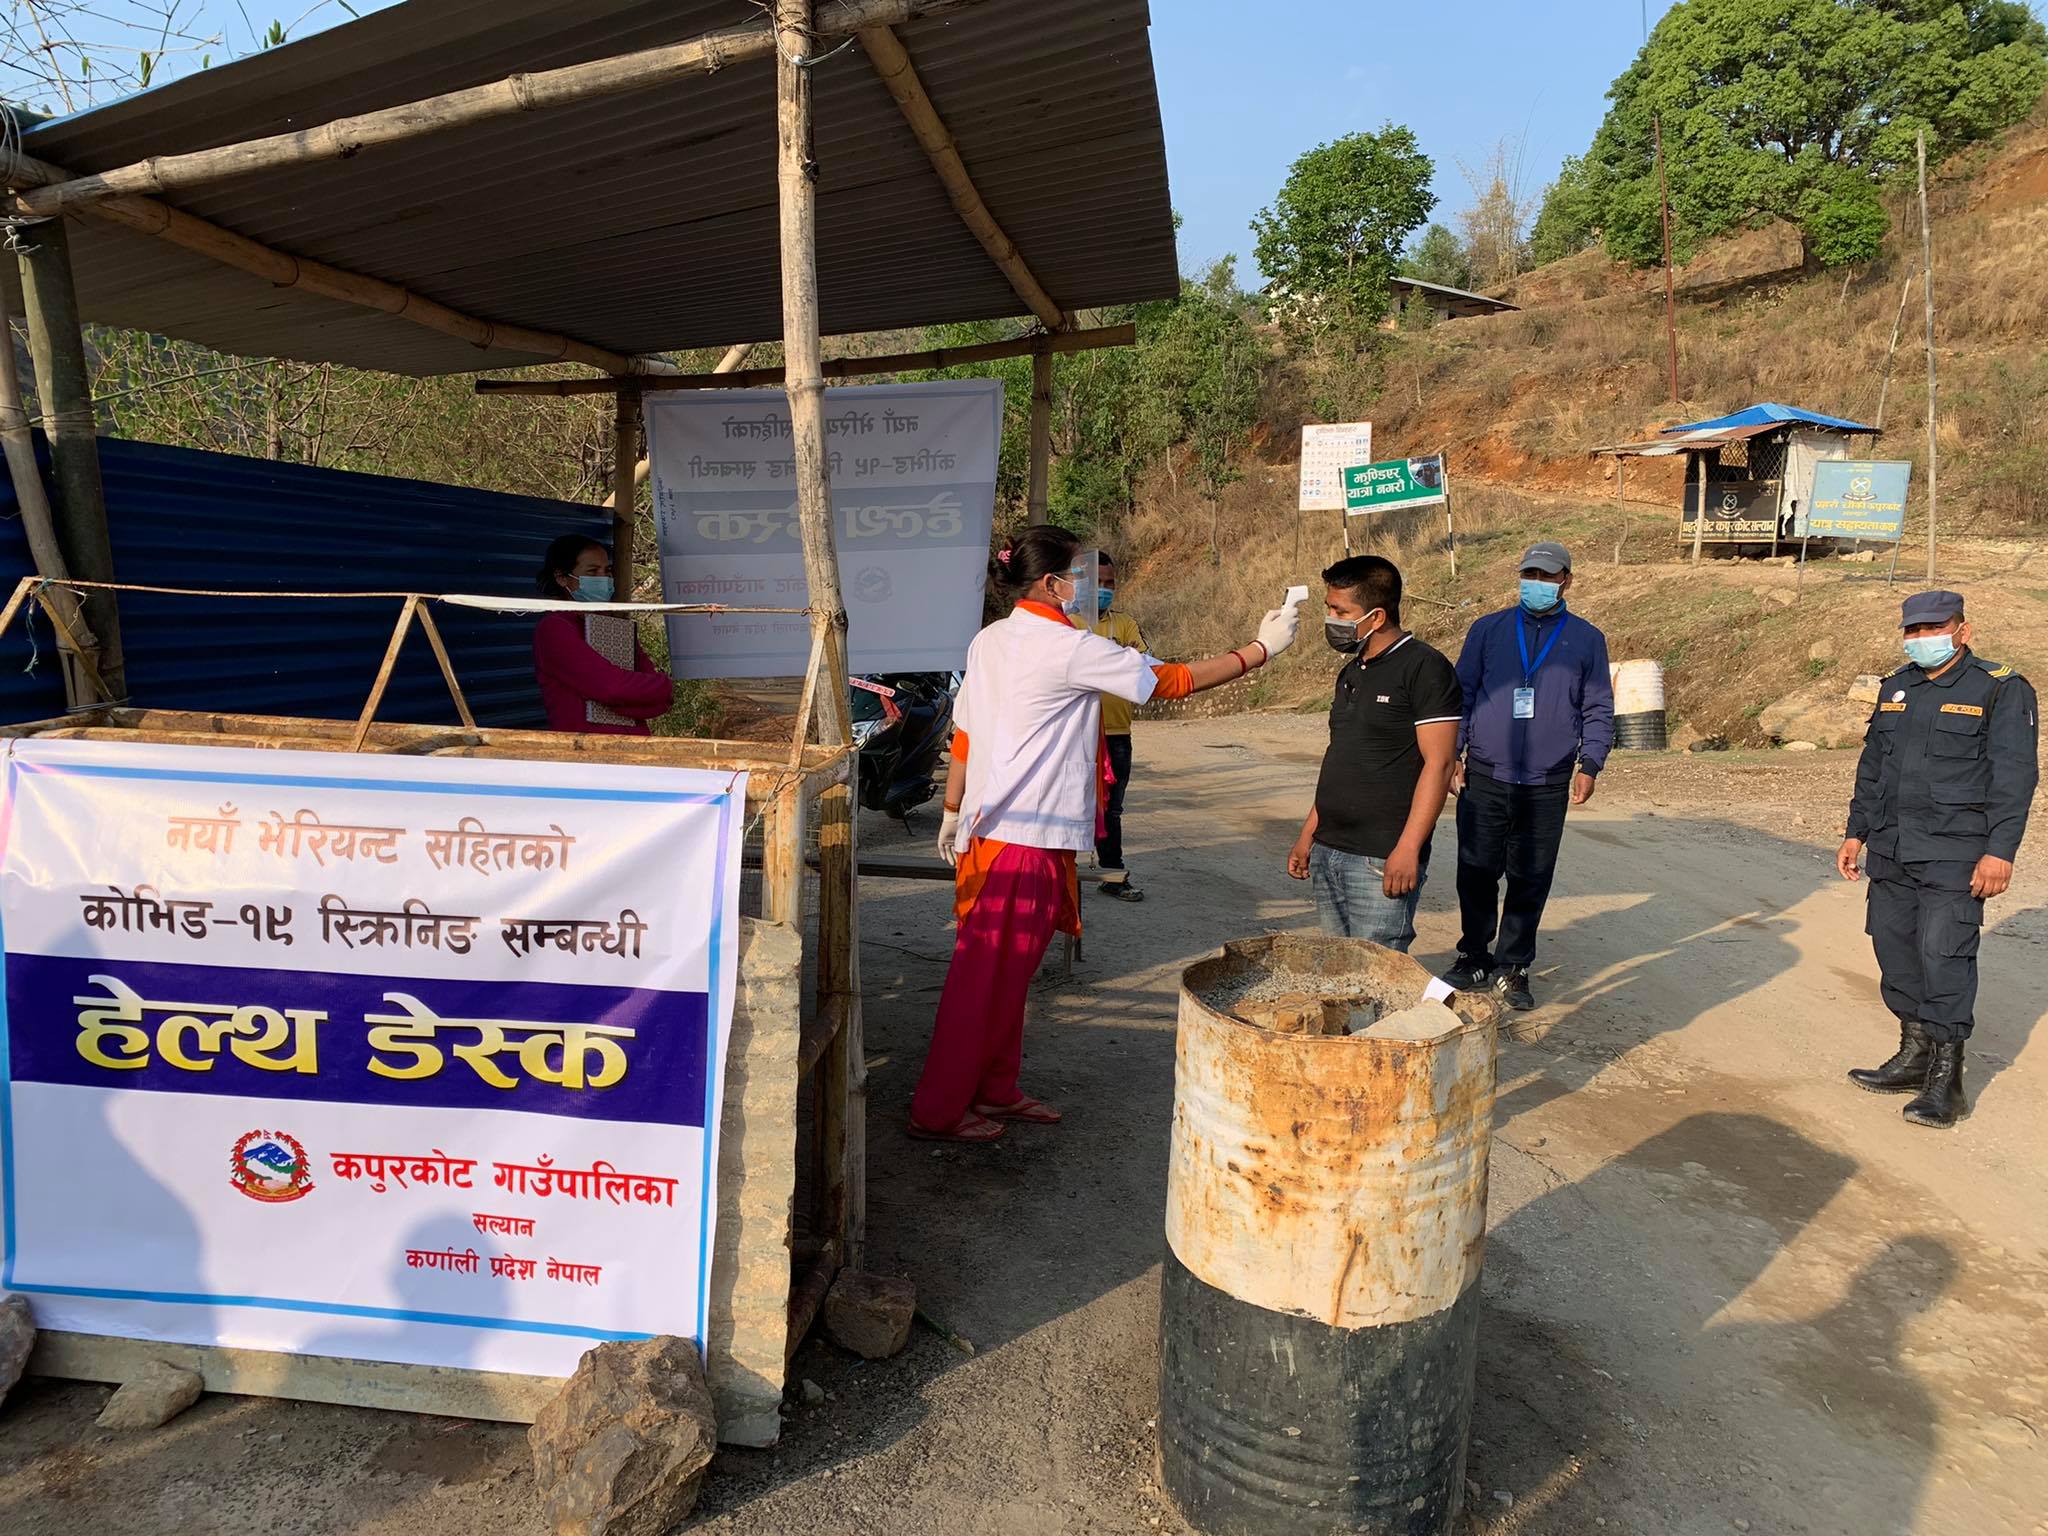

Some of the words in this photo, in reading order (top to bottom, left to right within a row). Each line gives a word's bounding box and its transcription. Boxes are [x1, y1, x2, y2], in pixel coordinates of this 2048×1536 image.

[1347, 486, 1373, 498] यात्रा
[167, 801, 240, 856] नयाँ
[258, 811, 407, 865] भेरियन्ट
[425, 817, 577, 875] सहितको
[81, 885, 293, 946] कोभिड-१९
[319, 894, 481, 955] स्क्रिनिङ
[500, 901, 648, 960] सम्बन्धी
[73, 974, 328, 1074] हेल्थ
[364, 992, 636, 1091] डेस्क
[330, 1148, 478, 1195] कपुरकोट
[493, 1152, 679, 1207] गाउँपालिका
[472, 1213, 536, 1238] सल्यान
[405, 1243, 479, 1274] कर्णाली
[490, 1254, 537, 1281] प्रदेश
[546, 1254, 603, 1287] नेपाल
